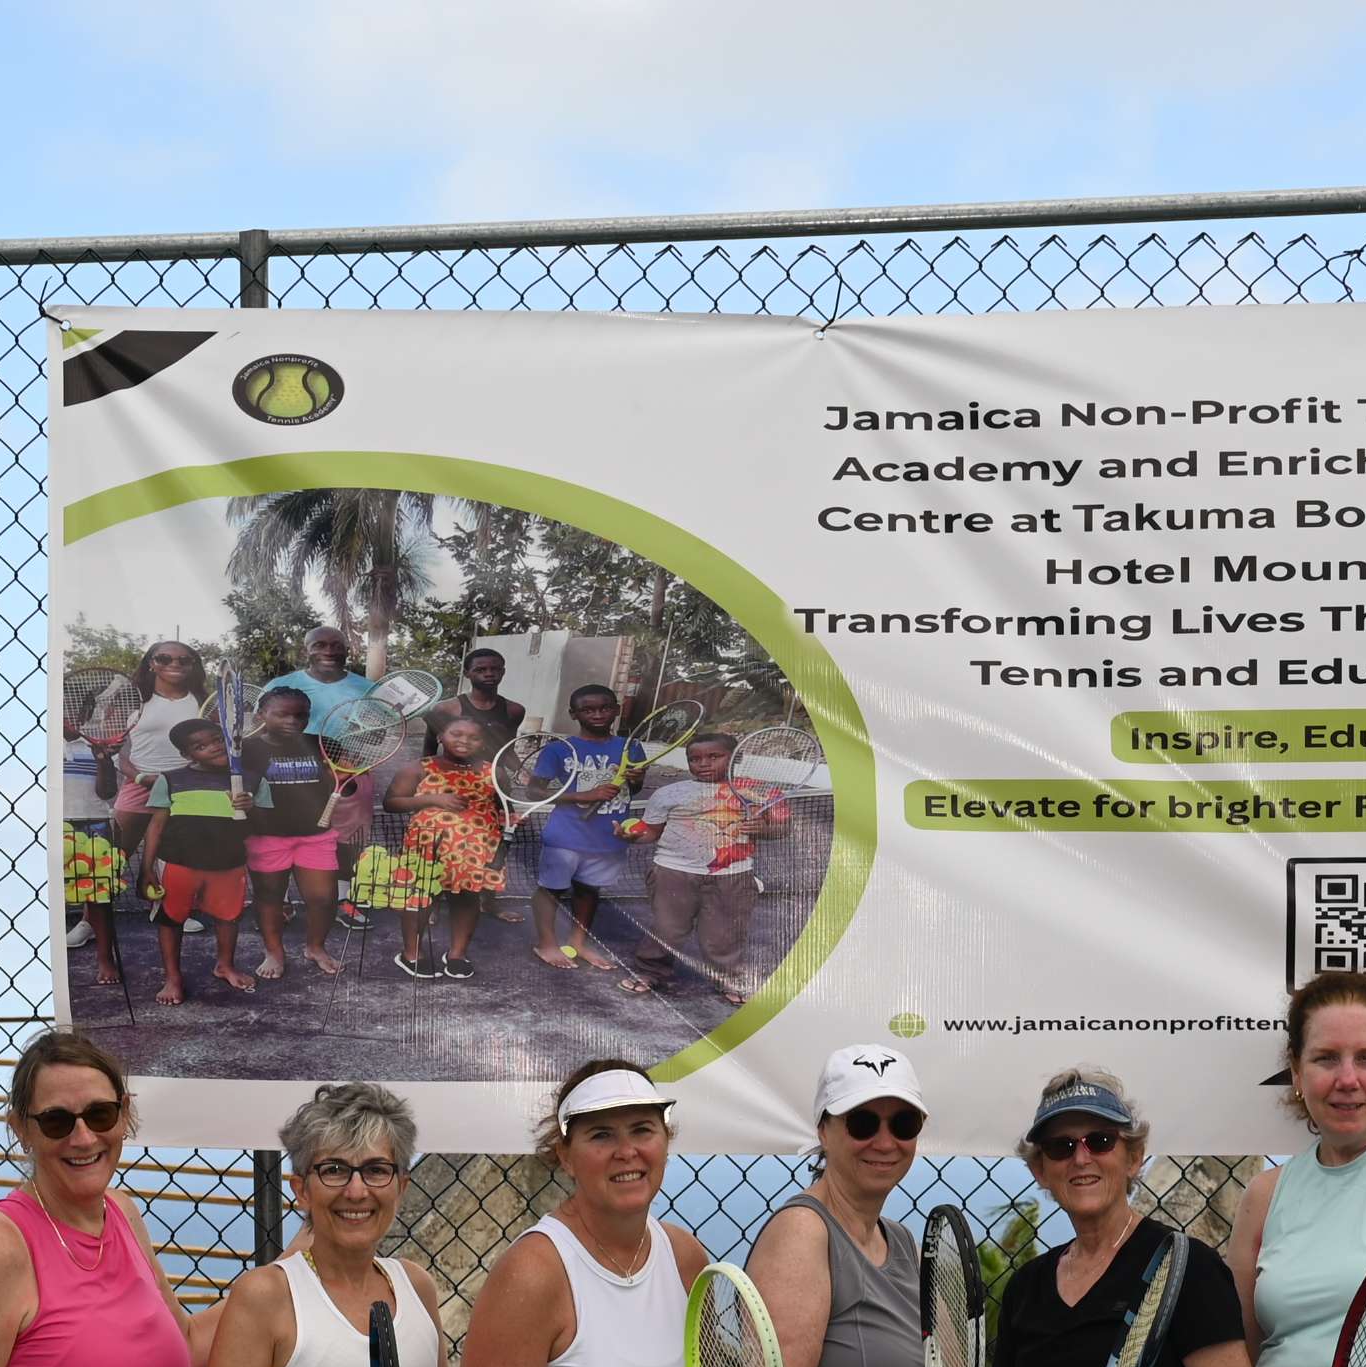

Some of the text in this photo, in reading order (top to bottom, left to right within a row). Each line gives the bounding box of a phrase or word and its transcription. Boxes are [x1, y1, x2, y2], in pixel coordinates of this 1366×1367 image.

[267, 415, 300, 426] Tennis
[823, 402, 1041, 432] Jamaica
[1061, 396, 1342, 428] Non-Profit
[832, 456, 1084, 487] Academy
[1098, 450, 1199, 480] and
[817, 505, 995, 535] Centre
[1010, 507, 1063, 533] at
[1073, 502, 1277, 533] Takuma
[1045, 555, 1191, 586] Hotel
[793, 606, 1152, 641] Transforming
[1172, 604, 1306, 635] Lives
[969, 659, 1143, 688] Tennis
[1158, 657, 1259, 687] and
[1130, 725, 1290, 756] Inspire,
[924, 794, 1082, 819] Elevate
[1092, 793, 1157, 819] for
[1168, 793, 1343, 827] brighter
